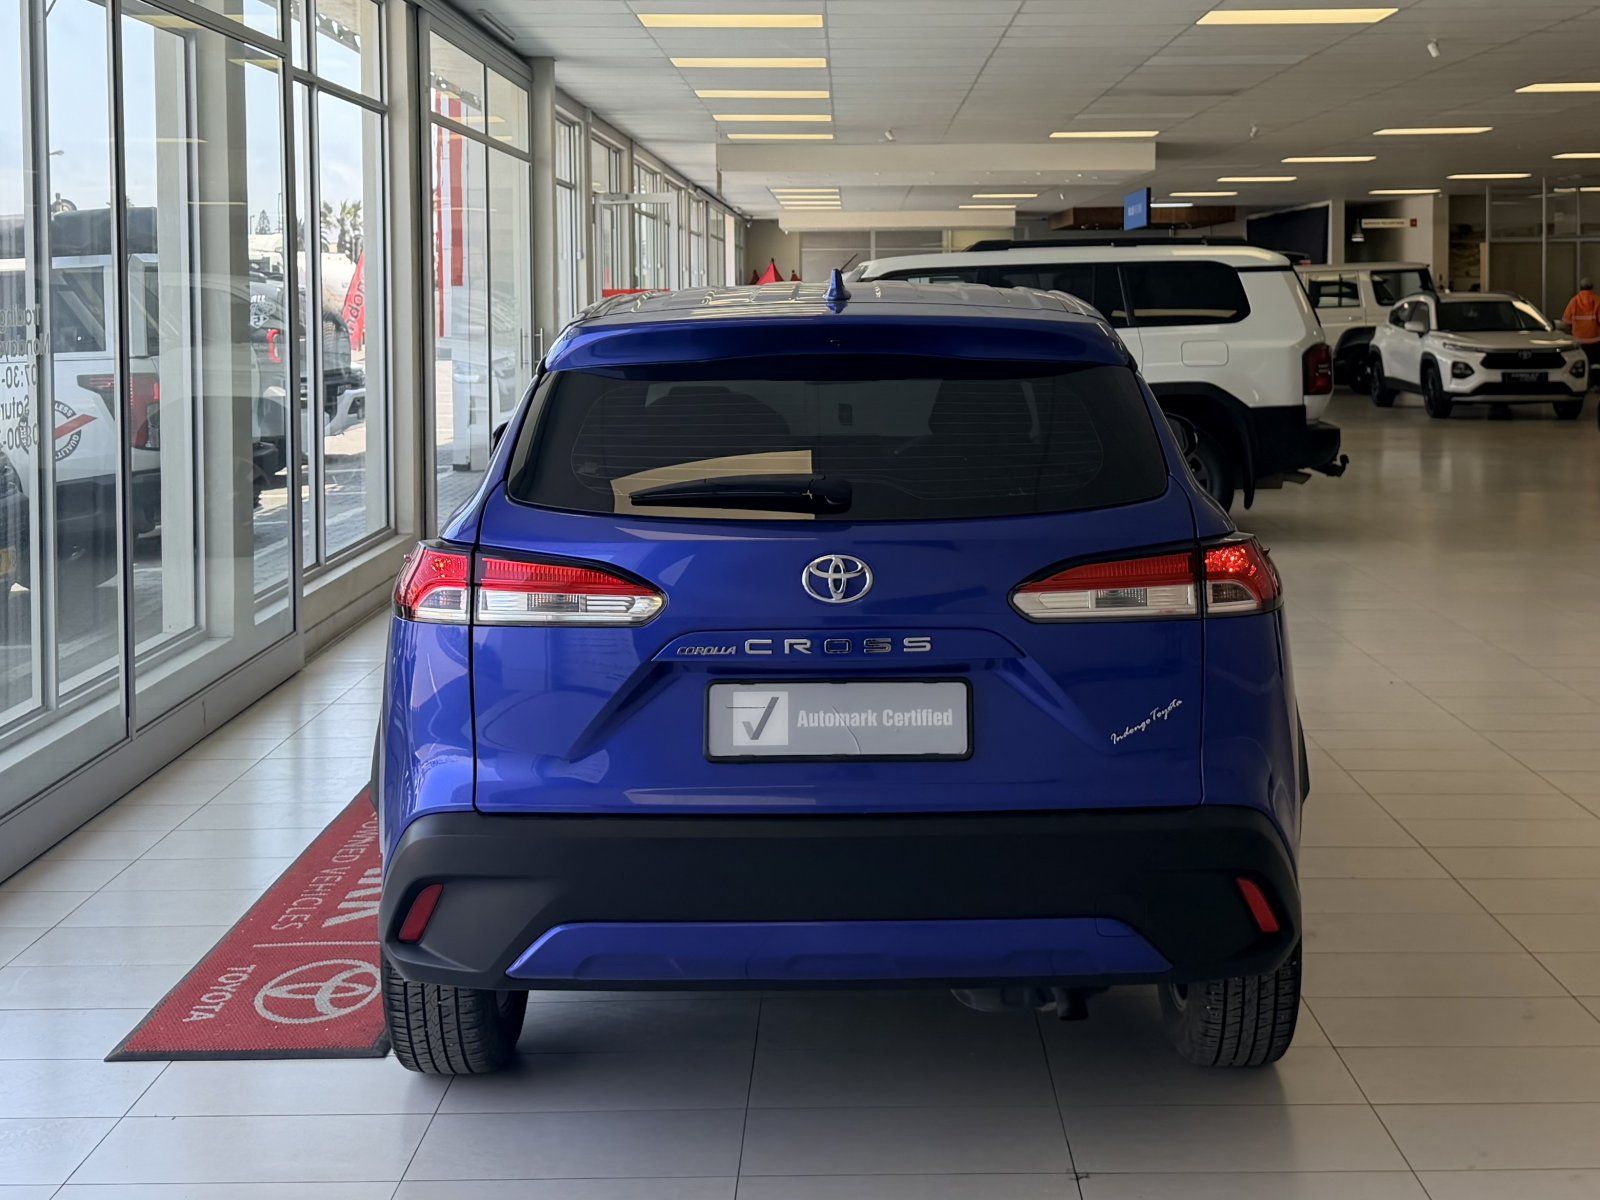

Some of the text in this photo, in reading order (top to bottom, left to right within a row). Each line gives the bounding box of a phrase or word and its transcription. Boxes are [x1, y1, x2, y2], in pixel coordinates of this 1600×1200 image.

[55, 402, 74, 417] LESS
[55, 434, 80, 460] QUALIT
[676, 636, 932, 656] COROLLA CROSS
[797, 708, 953, 728] Automark Certified
[1110, 698, 1183, 745] Indongo Toyota
[332, 811, 378, 863] OWNED
[271, 866, 351, 930] VEHICLES
[182, 964, 256, 1023] TOYOTA
